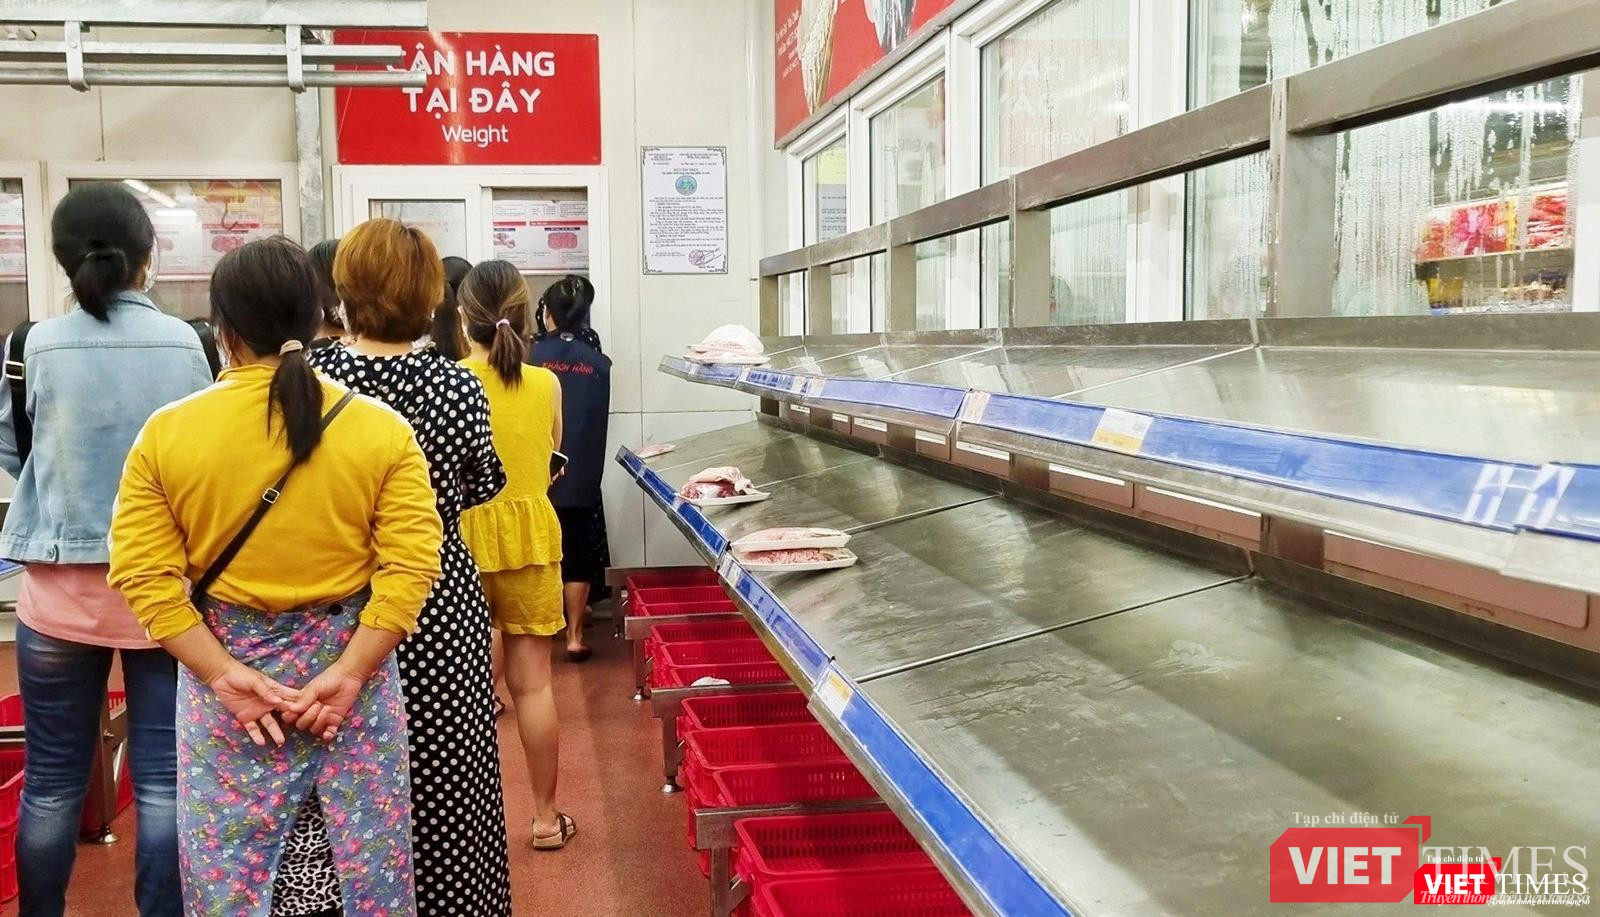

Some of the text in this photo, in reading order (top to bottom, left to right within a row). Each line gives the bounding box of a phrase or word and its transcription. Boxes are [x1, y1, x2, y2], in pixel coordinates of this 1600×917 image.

[386, 42, 555, 77] ÂN HÀNG
[402, 81, 541, 119] TẠI ĐÂY
[441, 124, 509, 148] Weight
